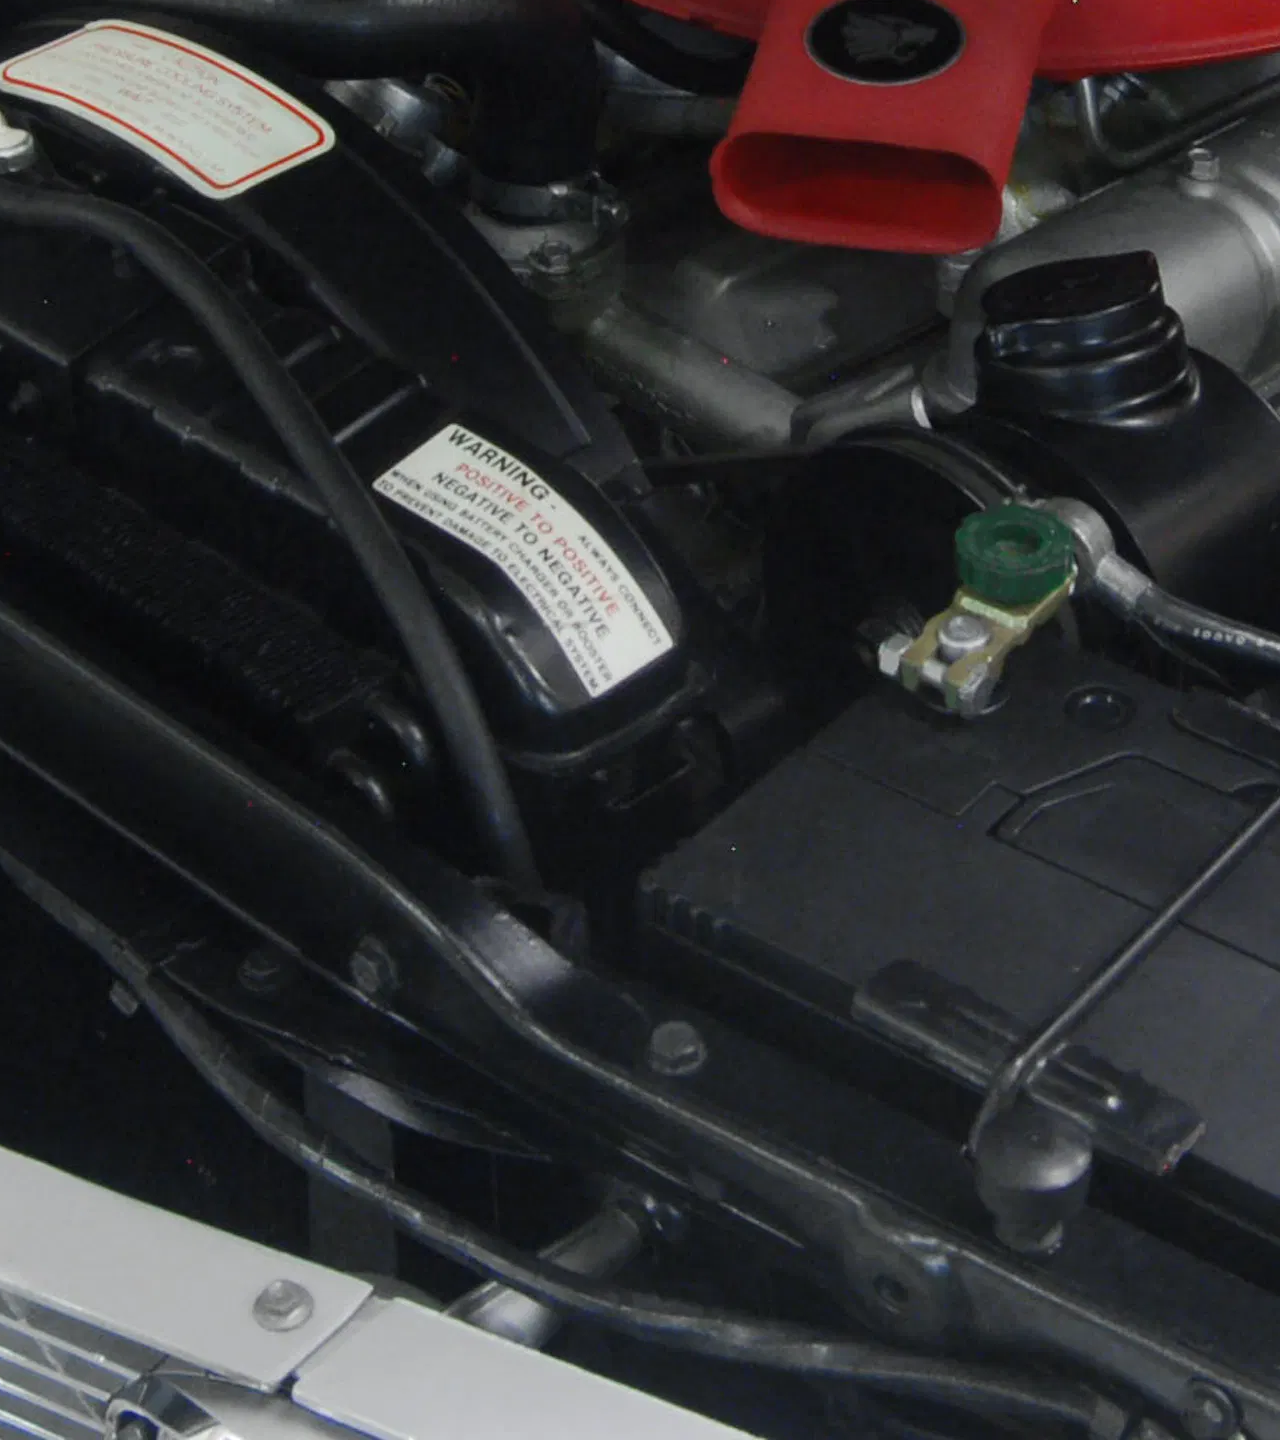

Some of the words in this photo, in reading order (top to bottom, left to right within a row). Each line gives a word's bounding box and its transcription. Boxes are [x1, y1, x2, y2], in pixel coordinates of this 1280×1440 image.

[377, 477, 395, 493] TO
[394, 487, 443, 519] PREVENT
[442, 516, 493, 549] DAMAGE
[491, 546, 509, 563] TO
[507, 562, 564, 635] ELECTRICAL
[390, 468, 422, 493] WHEN
[423, 489, 459, 513] USING
[458, 507, 508, 542] BATTERY
[508, 540, 559, 598] CHARGER
[556, 599, 574, 620] OR
[571, 621, 614, 683] BOOSTER
[432, 470, 515, 526] NEGATIVE
[514, 521, 539, 545] TO
[537, 547, 611, 640] NEGATIVE
[447, 428, 551, 501] WARNING
[577, 534, 620, 583] ALWAYS
[618, 583, 662, 647] CONNECT
[455, 462, 529, 513] POSITIVE
[530, 511, 554, 535] TO
[553, 536, 619, 617] POSITIVE
